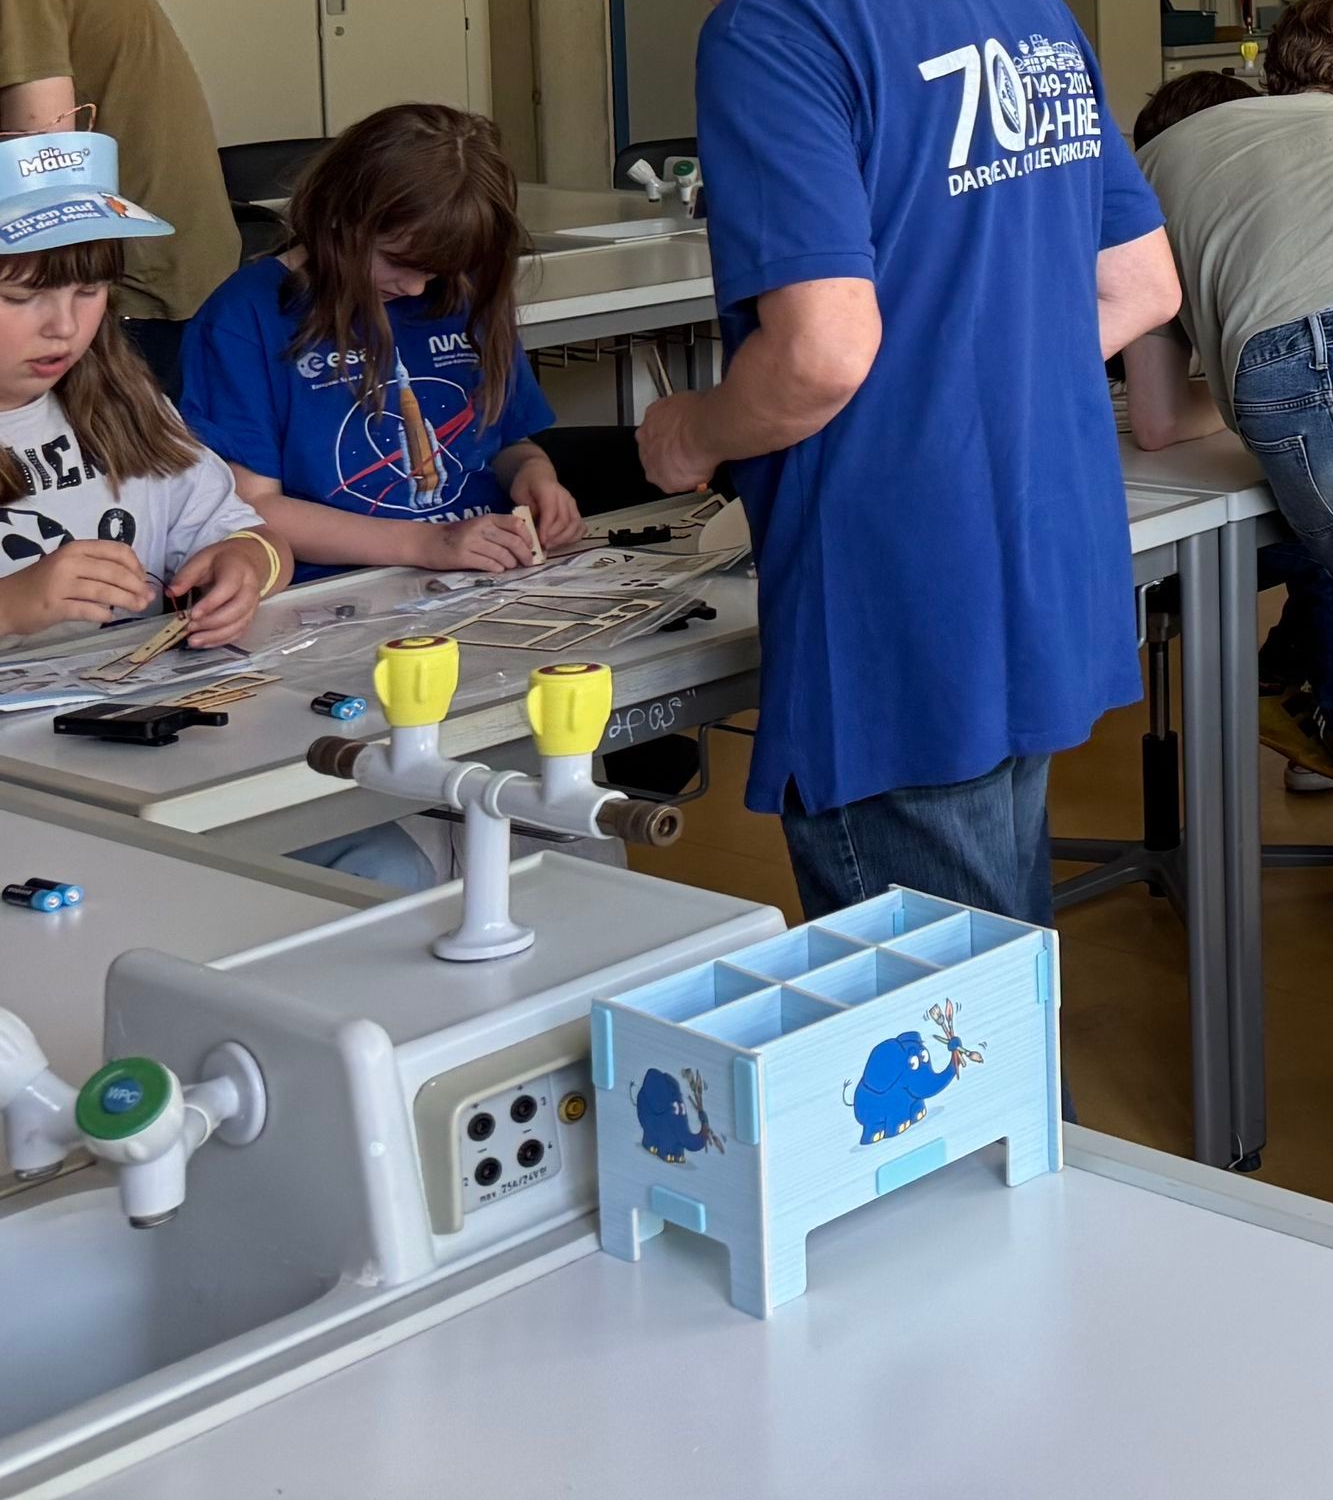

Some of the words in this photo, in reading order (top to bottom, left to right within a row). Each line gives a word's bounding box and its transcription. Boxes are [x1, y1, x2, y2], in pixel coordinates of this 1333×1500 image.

[918, 37, 1027, 169] 70
[19, 151, 84, 178] Maus
[2, 206, 60, 234] Türen
[61, 201, 96, 214] auf
